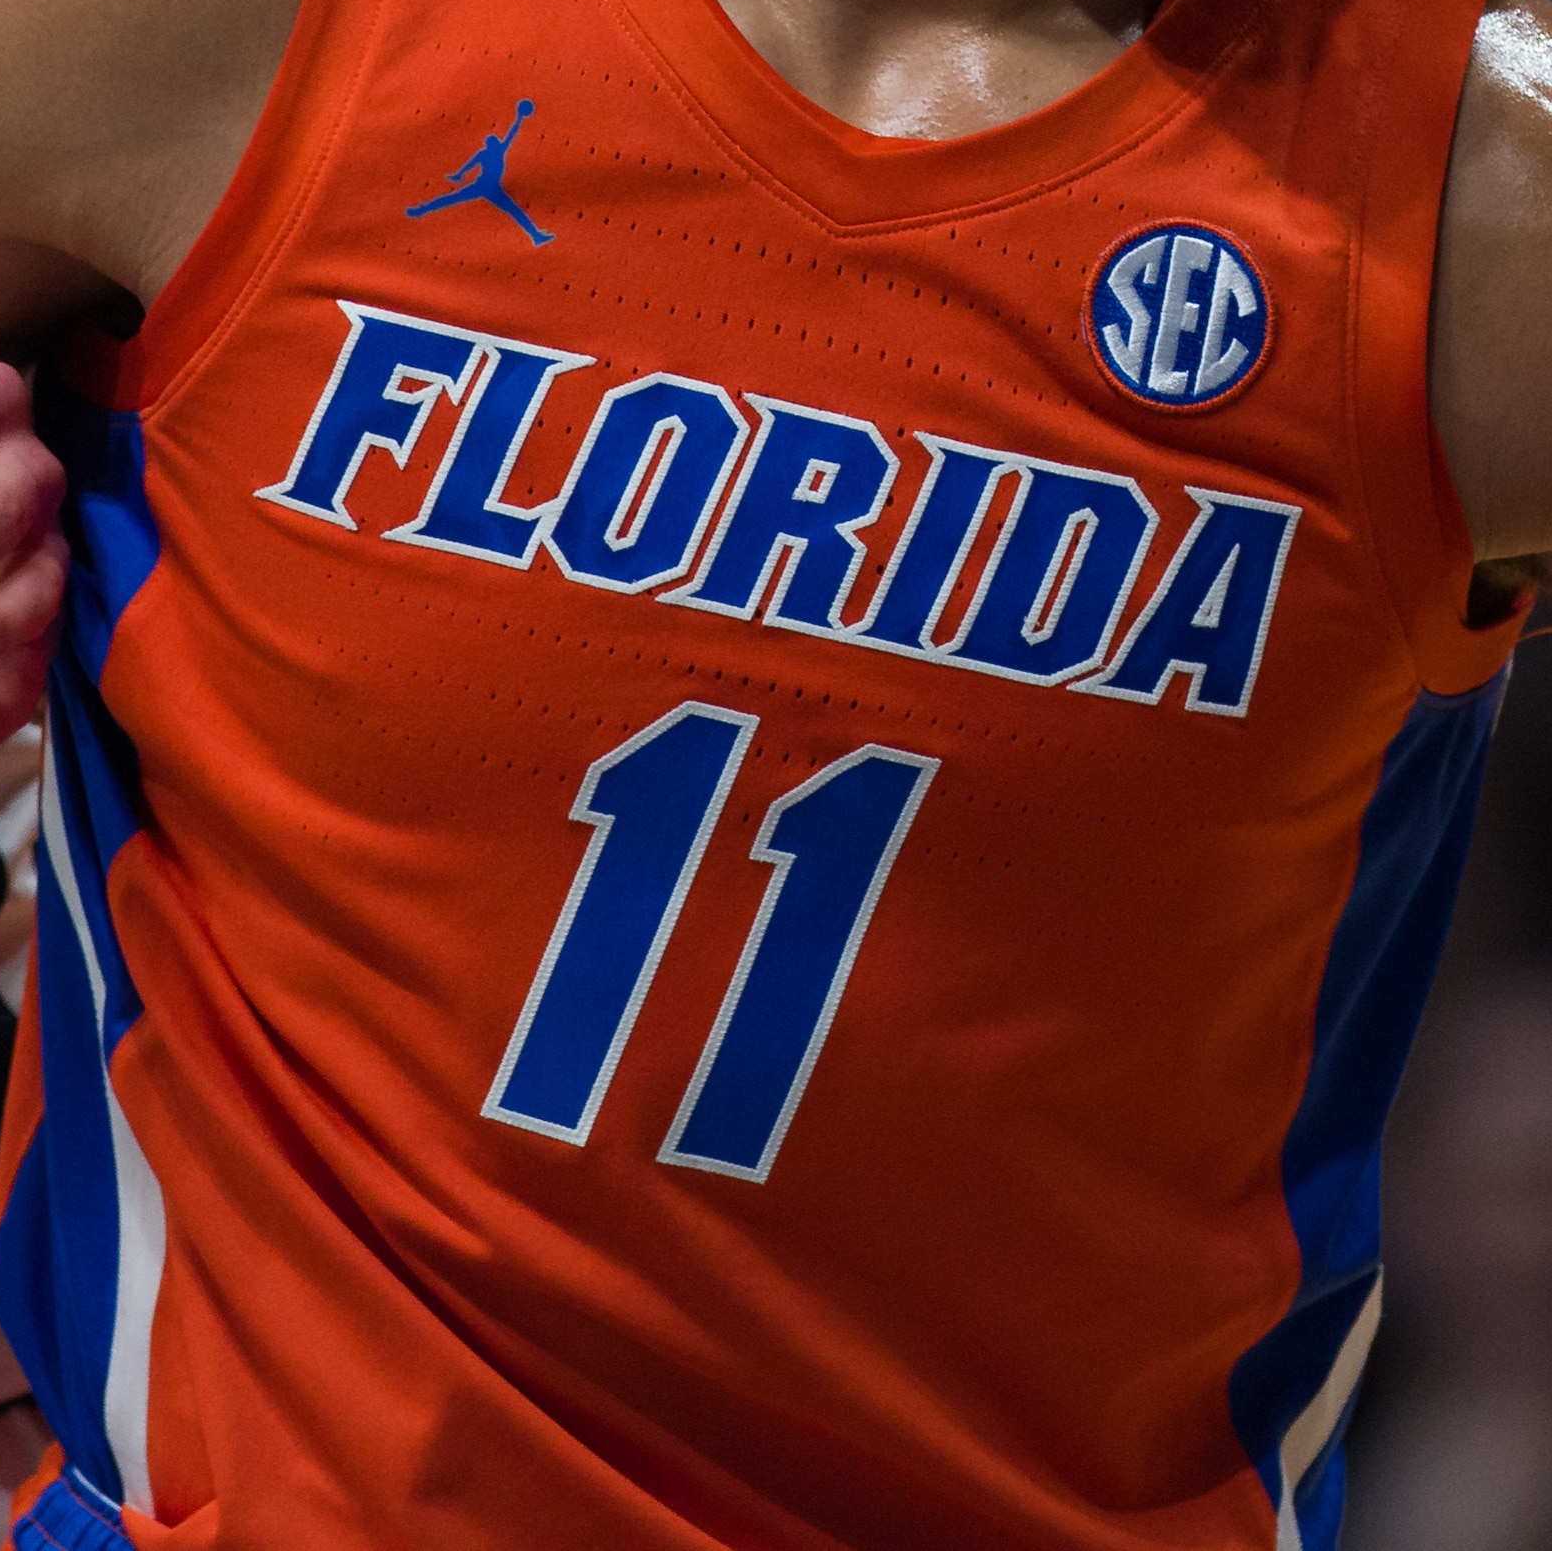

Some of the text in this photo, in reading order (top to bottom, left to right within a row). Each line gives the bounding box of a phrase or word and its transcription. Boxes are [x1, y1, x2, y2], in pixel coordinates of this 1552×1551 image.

[253, 299, 1303, 717] FLORIDA
[1102, 233, 1258, 397] SEC
[479, 699, 944, 1185] 11
